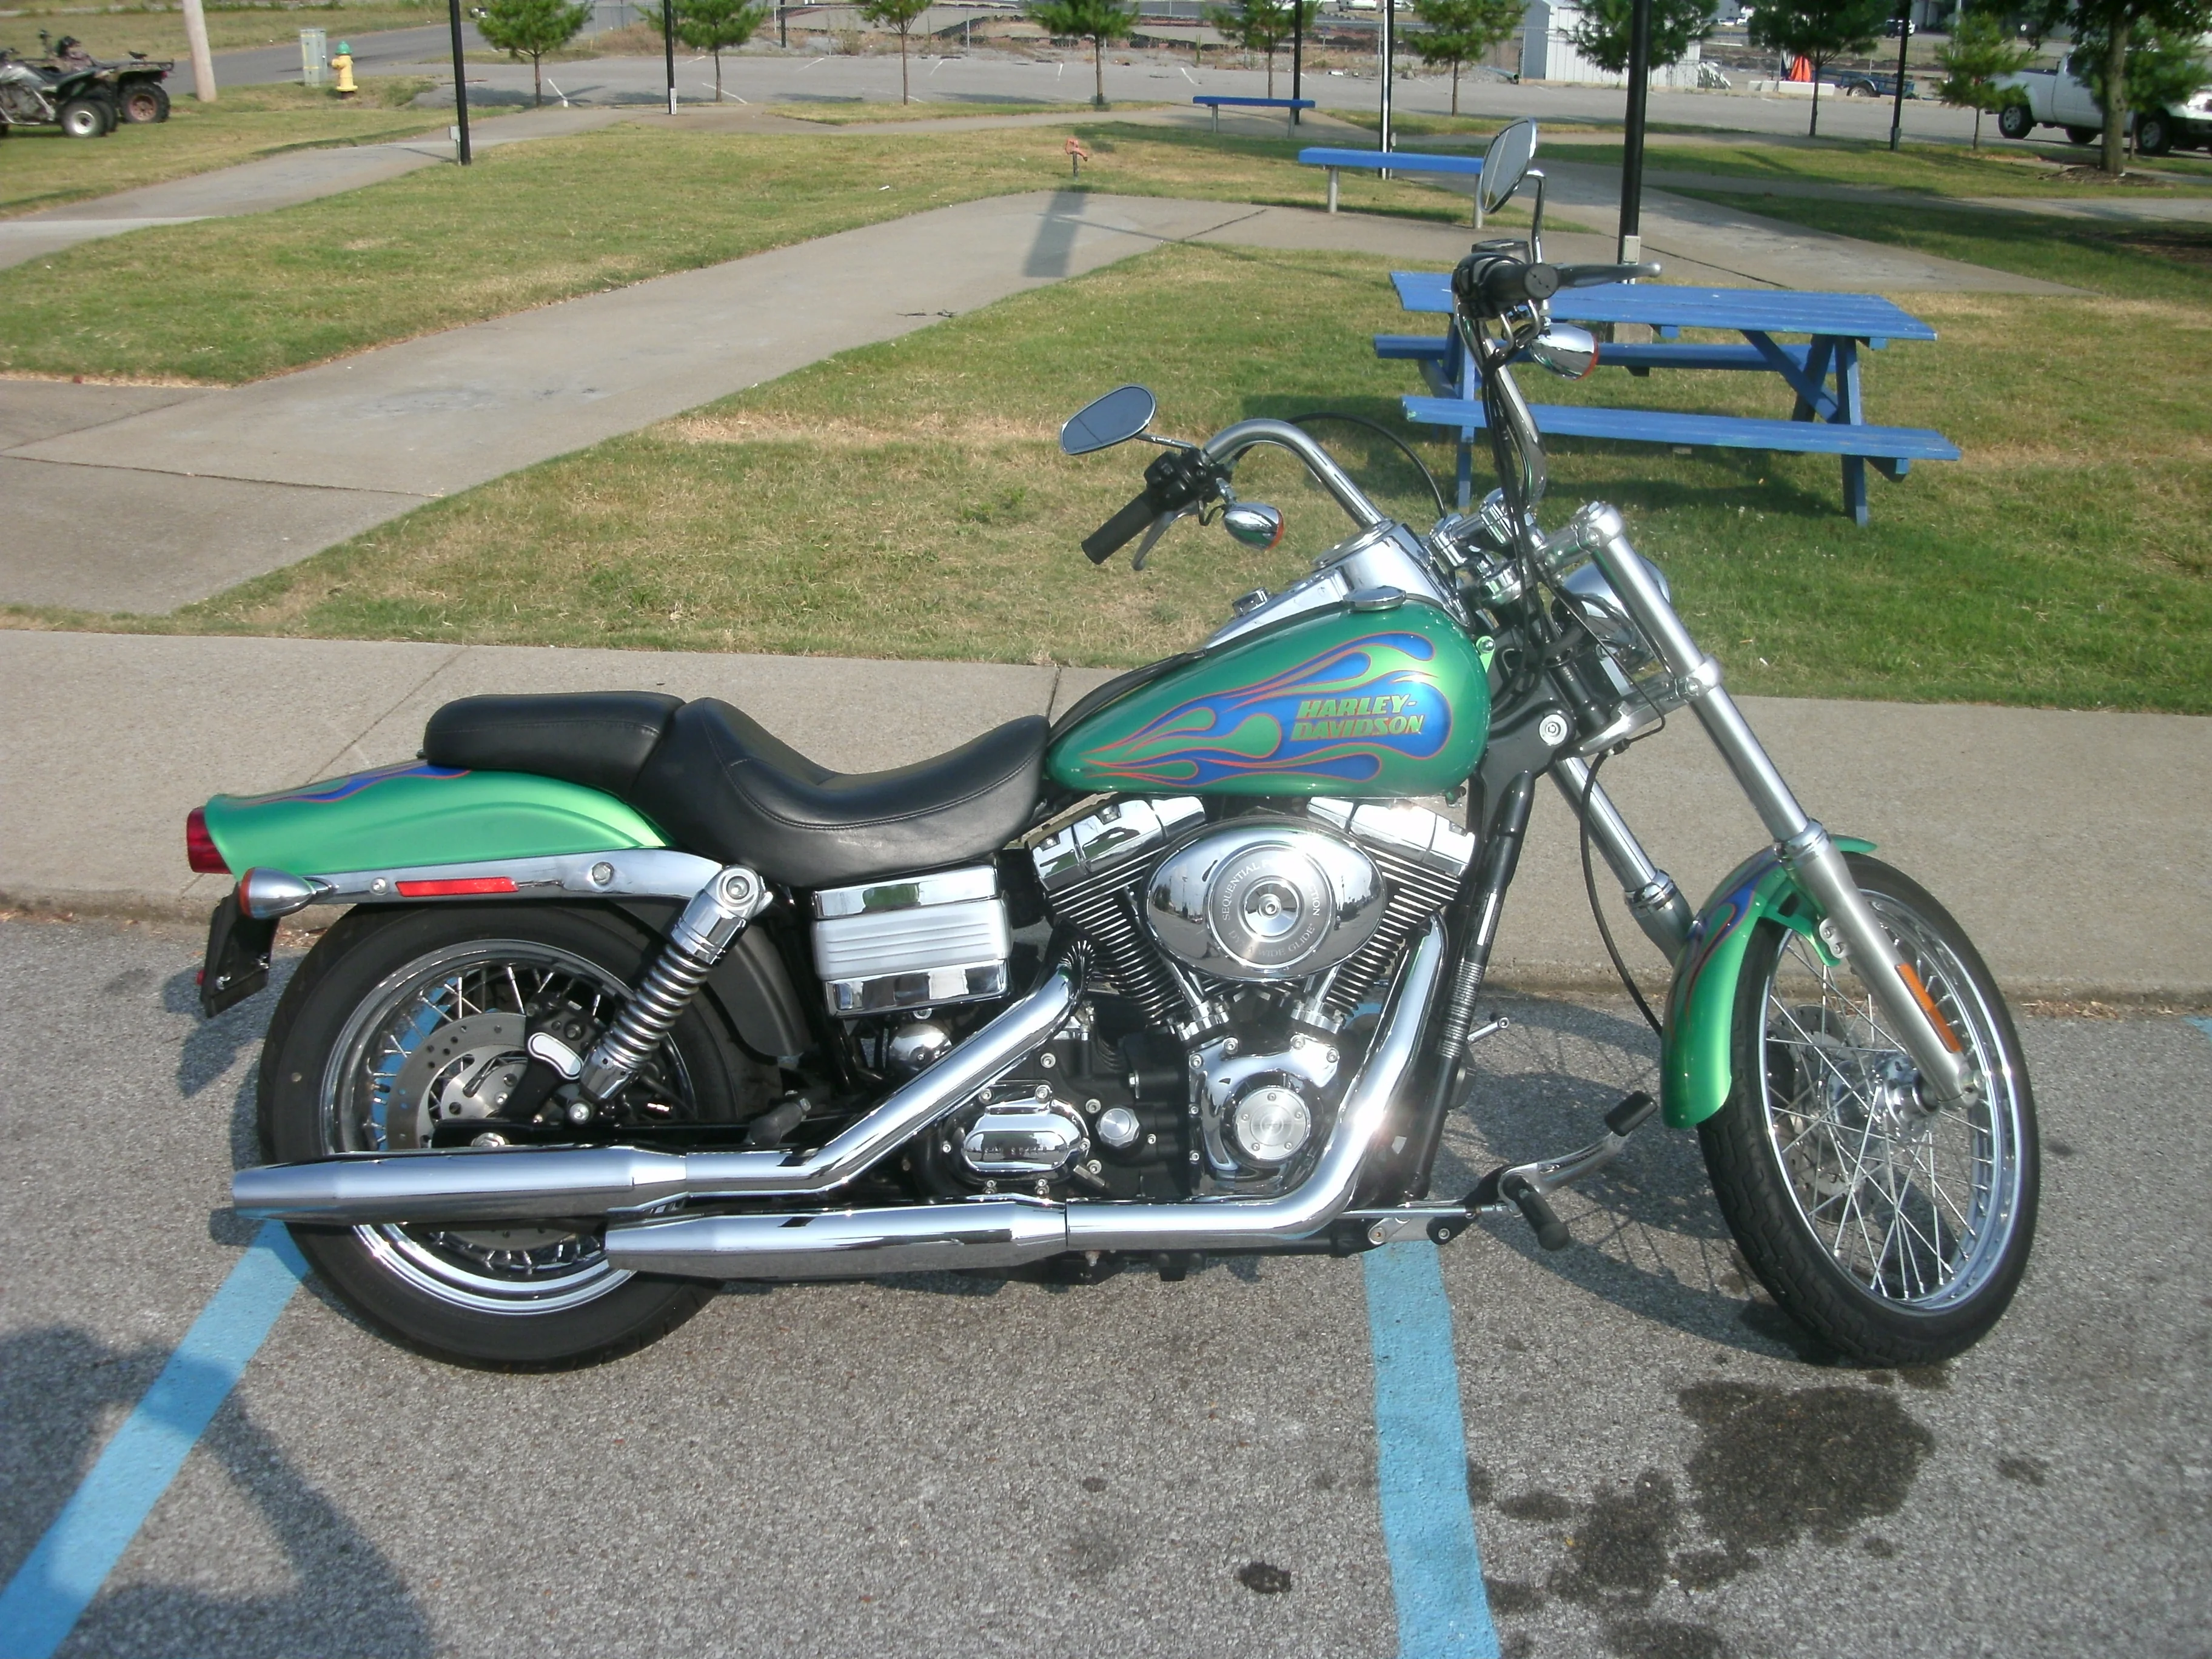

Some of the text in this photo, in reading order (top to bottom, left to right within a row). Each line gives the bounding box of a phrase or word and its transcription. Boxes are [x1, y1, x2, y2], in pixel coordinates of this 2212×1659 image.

[1296, 694, 1417, 719] HARLEY-
[1290, 715, 1424, 741] DAVIDSON
[1222, 862, 1260, 920] SEQUENTIAL
